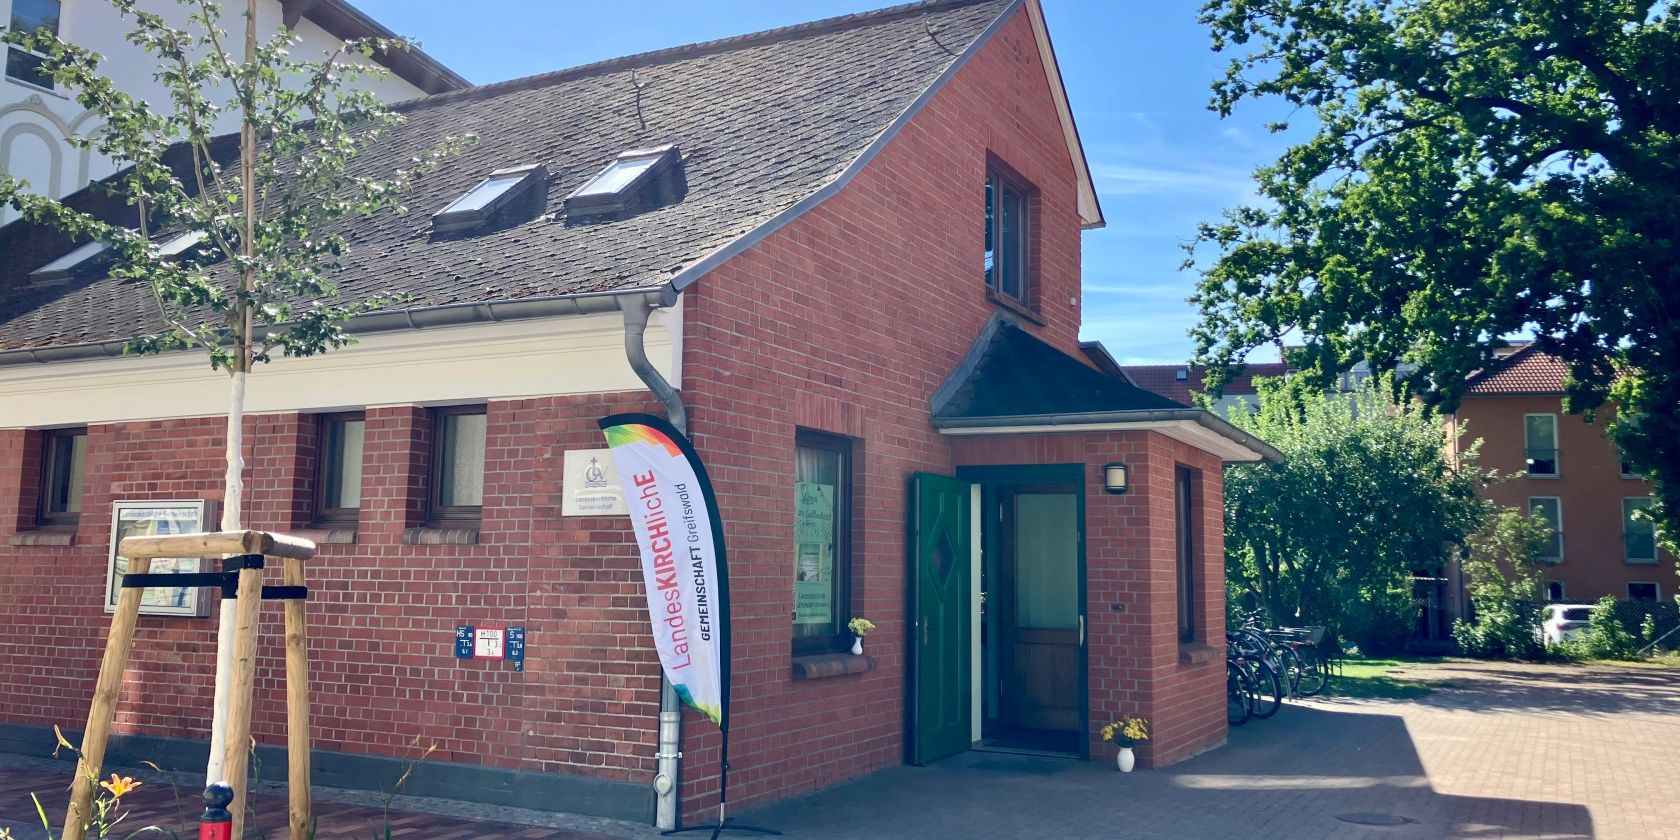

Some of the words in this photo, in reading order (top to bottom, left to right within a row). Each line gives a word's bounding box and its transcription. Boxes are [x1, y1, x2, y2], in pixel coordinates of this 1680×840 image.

[674, 483, 700, 543] Greifswald
[633, 470, 691, 671] LandesKIRCHlichE
[690, 546, 711, 641] GEMEINSCHAFT
[456, 630, 465, 638] HS
[509, 631, 515, 639] S
